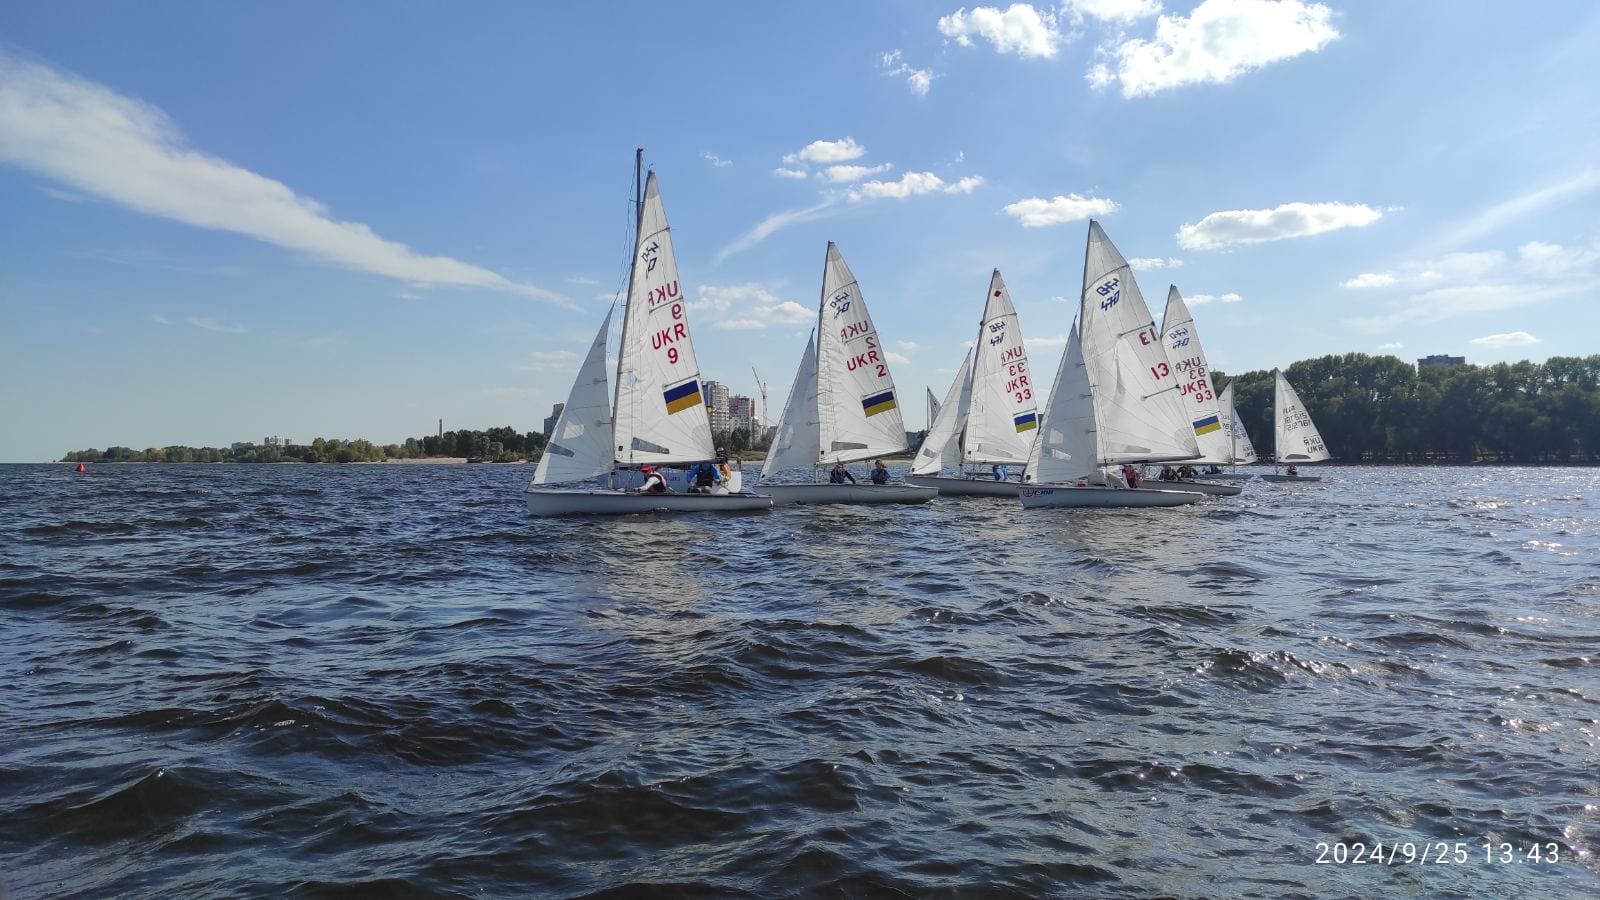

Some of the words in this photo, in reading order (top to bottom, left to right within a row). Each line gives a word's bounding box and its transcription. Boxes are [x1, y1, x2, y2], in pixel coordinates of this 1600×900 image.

[1101, 290, 1120, 311] 470
[652, 323, 687, 350] UKR
[667, 347, 679, 365] 9
[846, 350, 880, 372] UKR
[875, 364, 887, 378] 2
[1150, 362, 1170, 381] 13
[1005, 375, 1029, 393] UKR
[1180, 379, 1208, 396] UKR
[1015, 388, 1032, 404] 33
[1195, 389, 1214, 404] 93
[1306, 444, 1324, 454] UKR
